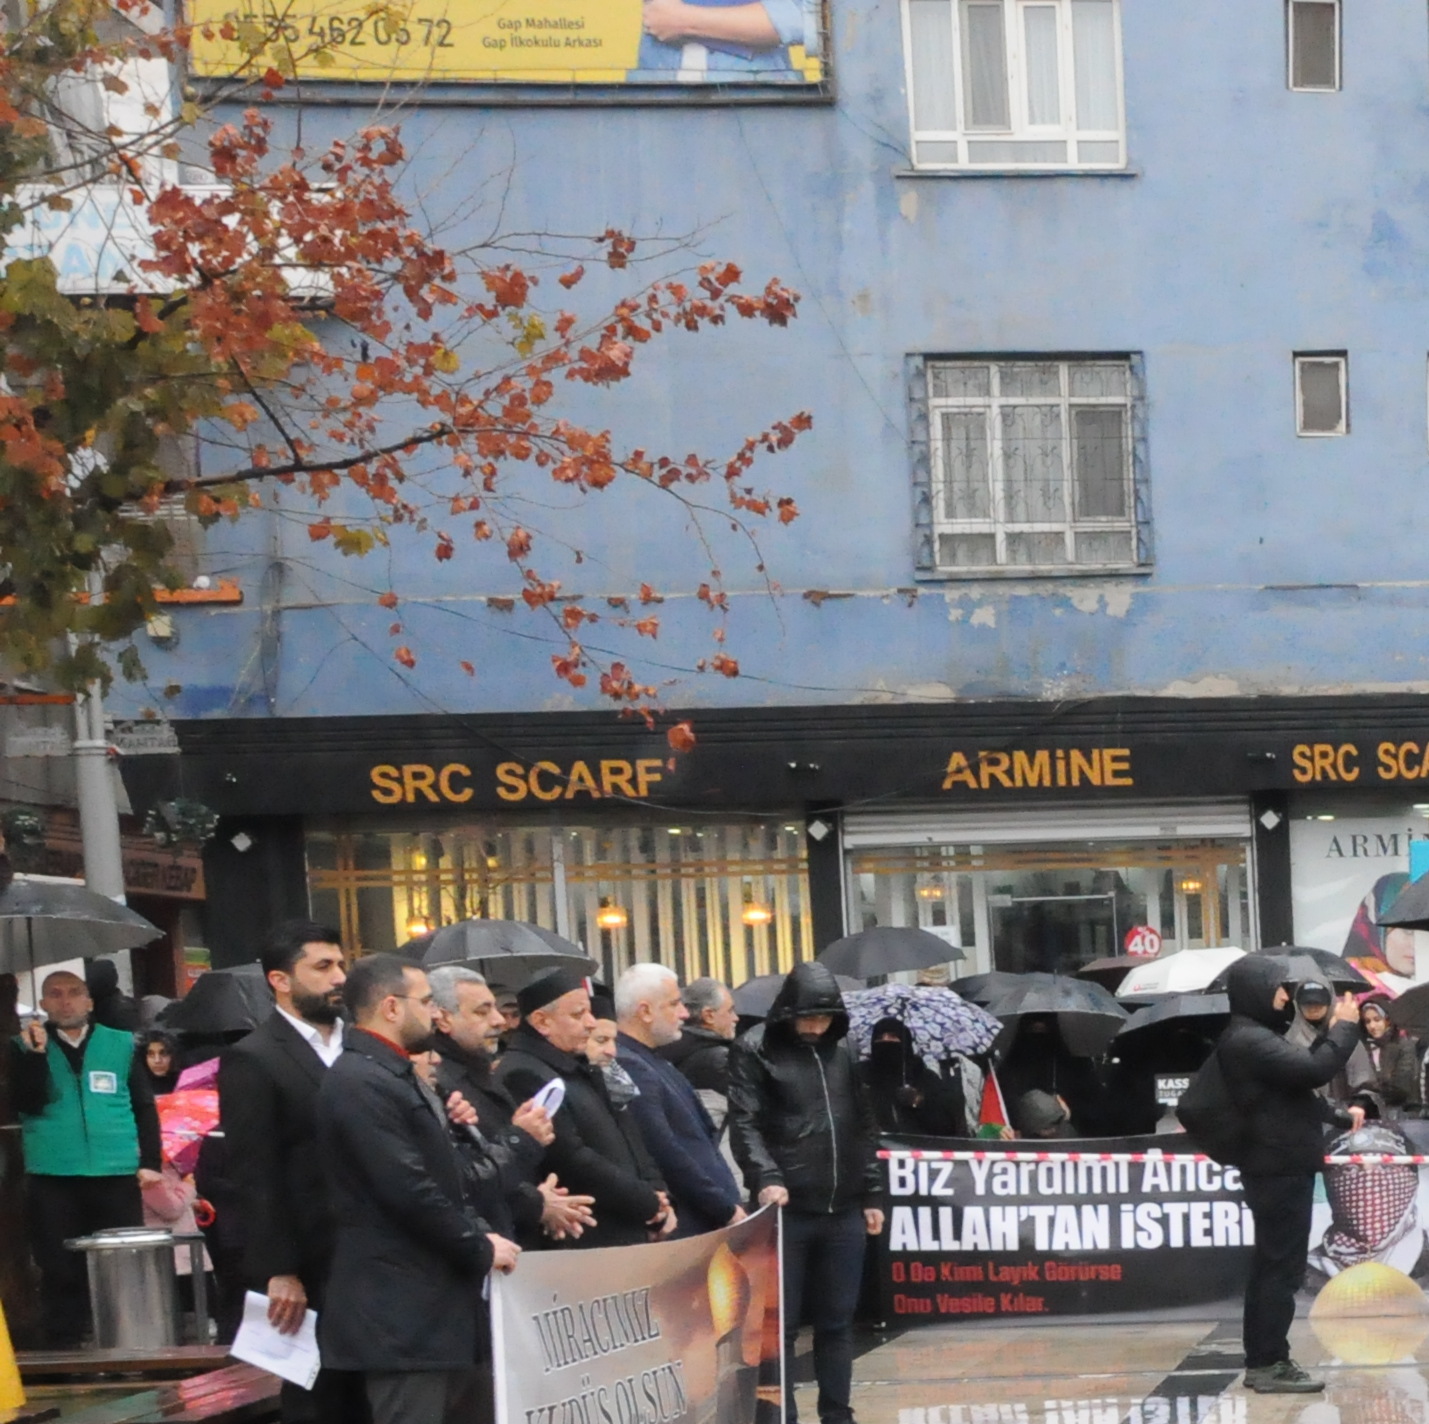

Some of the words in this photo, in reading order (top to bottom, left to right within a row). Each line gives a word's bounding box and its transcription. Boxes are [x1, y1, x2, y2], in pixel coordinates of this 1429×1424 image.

[307, 16, 367, 47] 462
[417, 17, 455, 48] 72
[497, 17, 522, 32] Gap
[525, 16, 585, 30] Mahallesi
[482, 35, 507, 51] Gap
[510, 33, 561, 49] İlkokulu
[564, 36, 603, 48] Arkası
[1292, 743, 1360, 783] SRC
[370, 763, 474, 804] SRC
[495, 758, 664, 802] SCARF
[1128, 934, 1161, 955] 40
[1044, 1260, 1122, 1281] Görürse
[894, 1294, 931, 1313] Onu
[937, 1293, 995, 1313] Vesile
